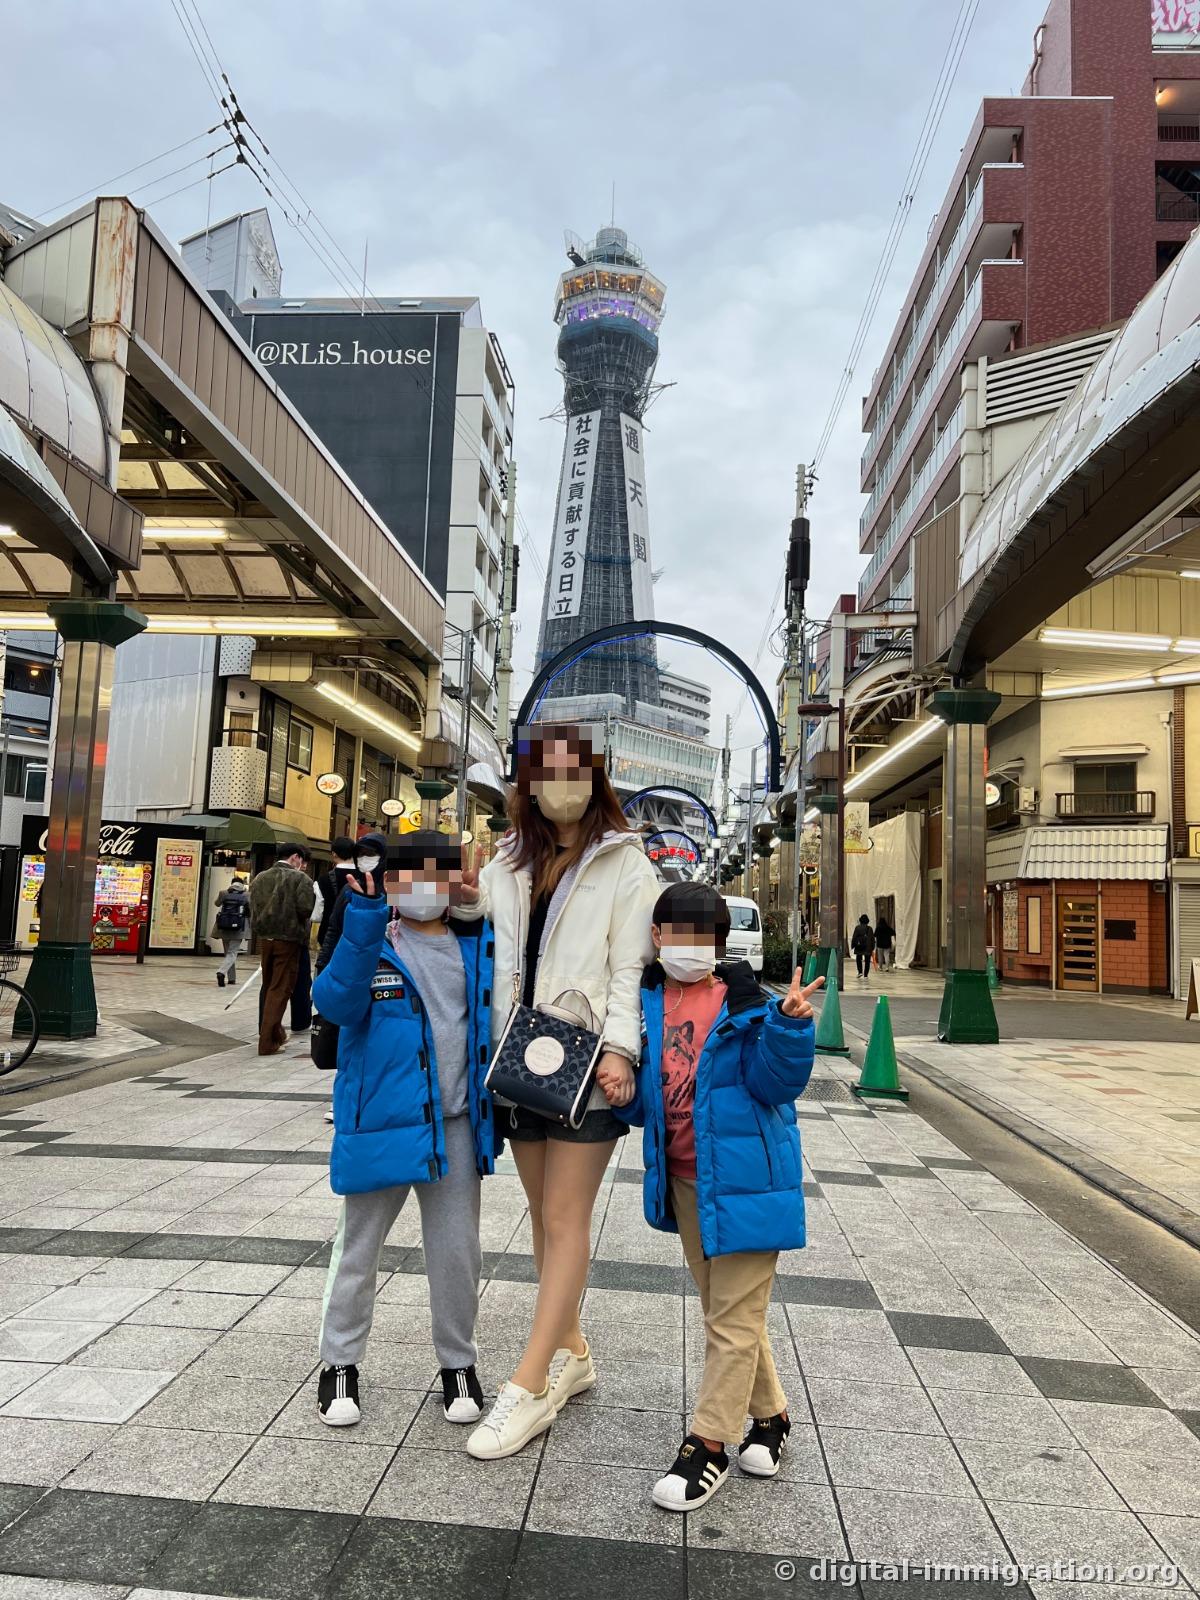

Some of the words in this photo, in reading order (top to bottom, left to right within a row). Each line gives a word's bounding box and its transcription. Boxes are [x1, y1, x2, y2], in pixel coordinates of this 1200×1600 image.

[255, 340, 431, 366] @RLiS_house
[554, 415, 592, 616] 社会に貢献する日立
[624, 424, 647, 563] 通天閣
[668, 1111, 691, 1120] WILD
